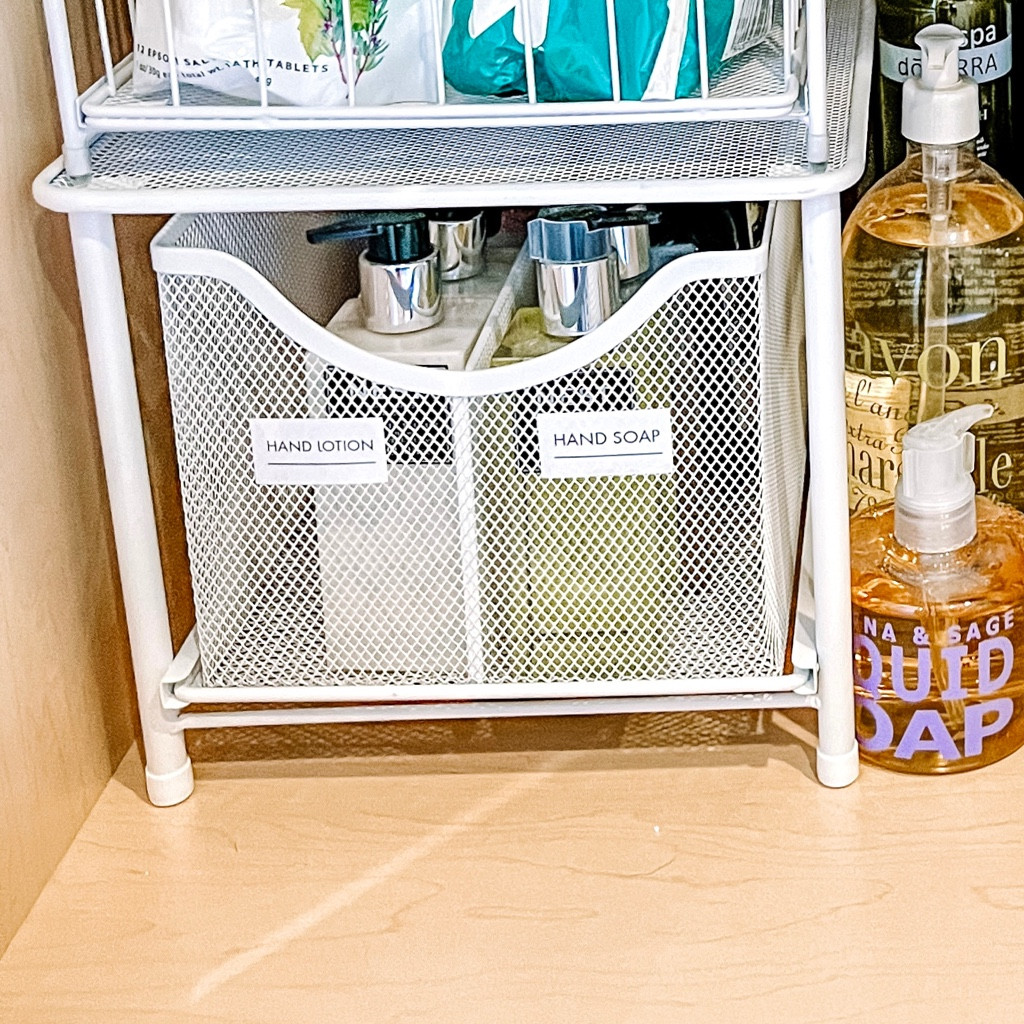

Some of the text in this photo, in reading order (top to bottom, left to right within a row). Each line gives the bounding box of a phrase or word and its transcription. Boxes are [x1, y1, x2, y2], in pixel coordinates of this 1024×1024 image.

[225, 58, 259, 68] ATH
[266, 58, 329, 73] TABLETS
[851, 319, 1012, 389] avon
[266, 438, 374, 454] HAND LOTION
[553, 429, 661, 447] HAND SOAP
[848, 423, 887, 450] xtra
[913, 608, 1015, 646] & SAGE
[854, 634, 1014, 704] QUID
[855, 697, 1014, 761] OAP
